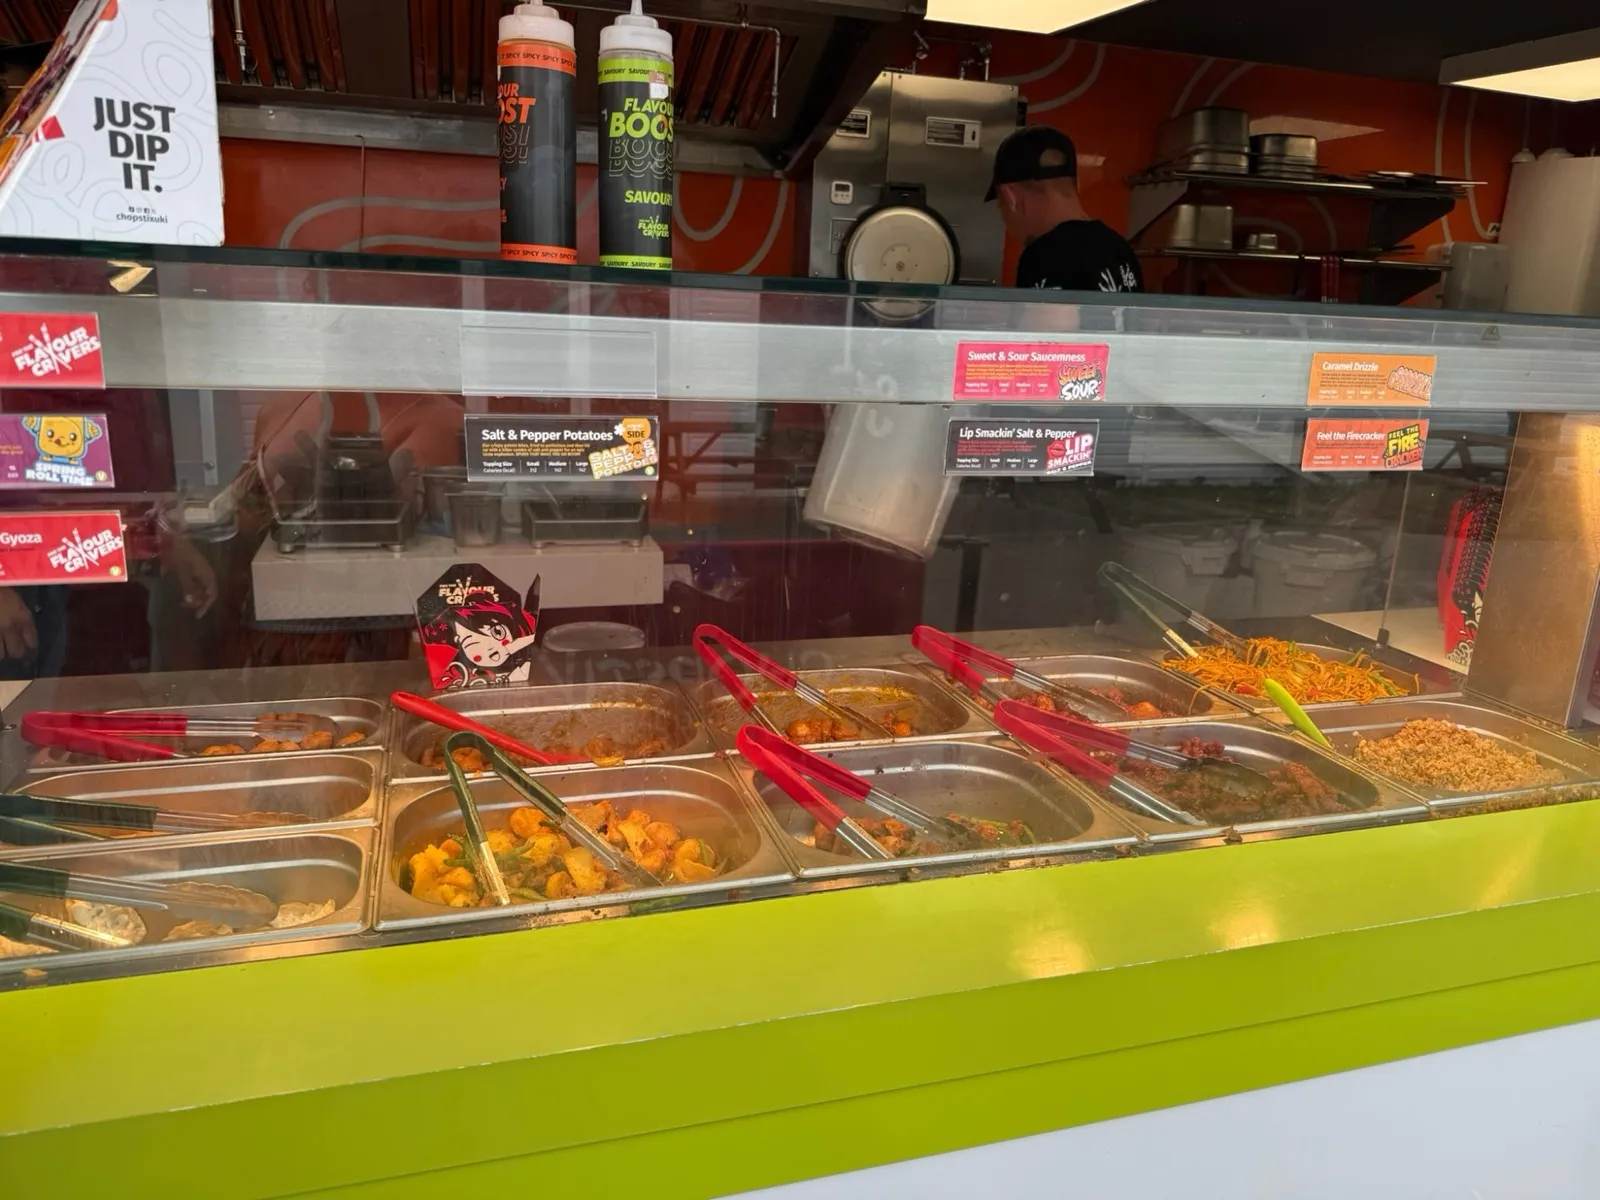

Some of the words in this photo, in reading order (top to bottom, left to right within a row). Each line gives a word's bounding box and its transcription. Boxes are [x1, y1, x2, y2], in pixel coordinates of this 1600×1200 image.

[93, 96, 176, 134] JUST
[624, 97, 674, 117] FLAVOU
[609, 112, 674, 143] BOOS
[108, 130, 169, 162] DIP
[122, 162, 163, 193] IT.
[624, 190, 672, 206] SAVOUR
[116, 211, 168, 224] chopstixuki
[14, 325, 89, 371] FLAVOUR
[968, 351, 996, 361] Sweet
[998, 351, 1006, 361] &
[1008, 351, 1029, 361] Sour
[1322, 361, 1353, 371] Caramel
[1354, 362, 1379, 372] Drizzle
[1062, 380, 1098, 401] SOUR
[482, 429, 505, 440] Salt
[508, 430, 518, 440] &
[520, 430, 561, 443] Pepper
[563, 430, 614, 441] Potatoes
[959, 427, 973, 439] Lip
[974, 427, 1016, 438] Smackin'
[1016, 428, 1034, 438] Salt
[1035, 429, 1043, 438] &
[1045, 429, 1077, 440] Pepper
[1317, 431, 1332, 440] Feel
[1333, 431, 1346, 440] the
[1347, 431, 1385, 440] Firecracker
[1389, 430, 1404, 439] FEEL
[1406, 425, 1419, 434] THE
[589, 444, 629, 461] SALT
[1065, 433, 1094, 455] LIP
[1388, 433, 1420, 456] FIRE
[593, 447, 656, 471] PEPPR
[1046, 449, 1092, 469] SMACKIN'
[25, 468, 60, 482] ROLL
[0, 532, 42, 547] Gyoza
[49, 529, 114, 569] FLAVOUR
